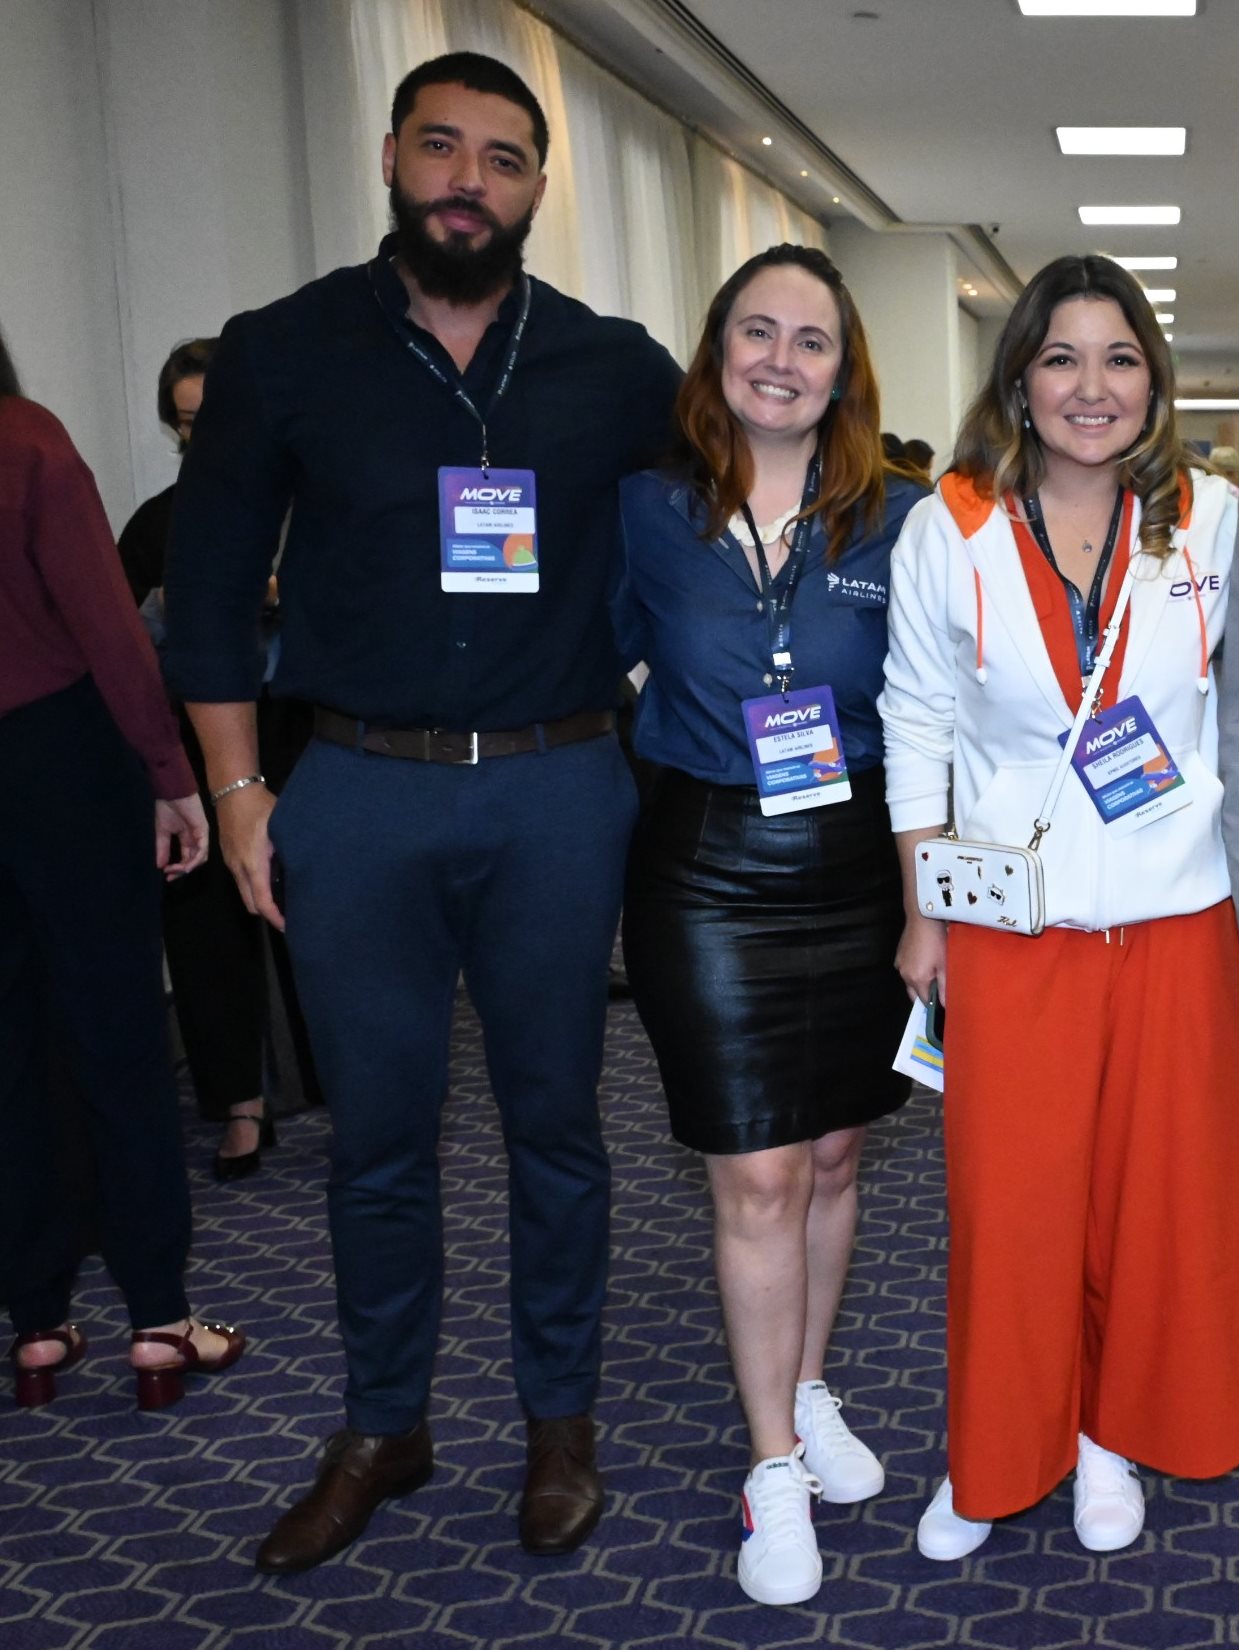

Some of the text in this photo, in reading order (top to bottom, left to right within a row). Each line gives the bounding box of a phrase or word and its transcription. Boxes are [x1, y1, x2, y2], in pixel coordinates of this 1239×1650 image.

[460, 488, 523, 502] MOVE
[842, 578, 886, 595] LATAM
[1170, 575, 1219, 597] OVE
[764, 705, 821, 728] MOVE
[773, 729, 814, 743] ESTELA SILVA
[1086, 717, 1137, 755] MOVE
[1092, 756, 1112, 769] SHEILA
[1113, 738, 1144, 761] RODRIGUES
